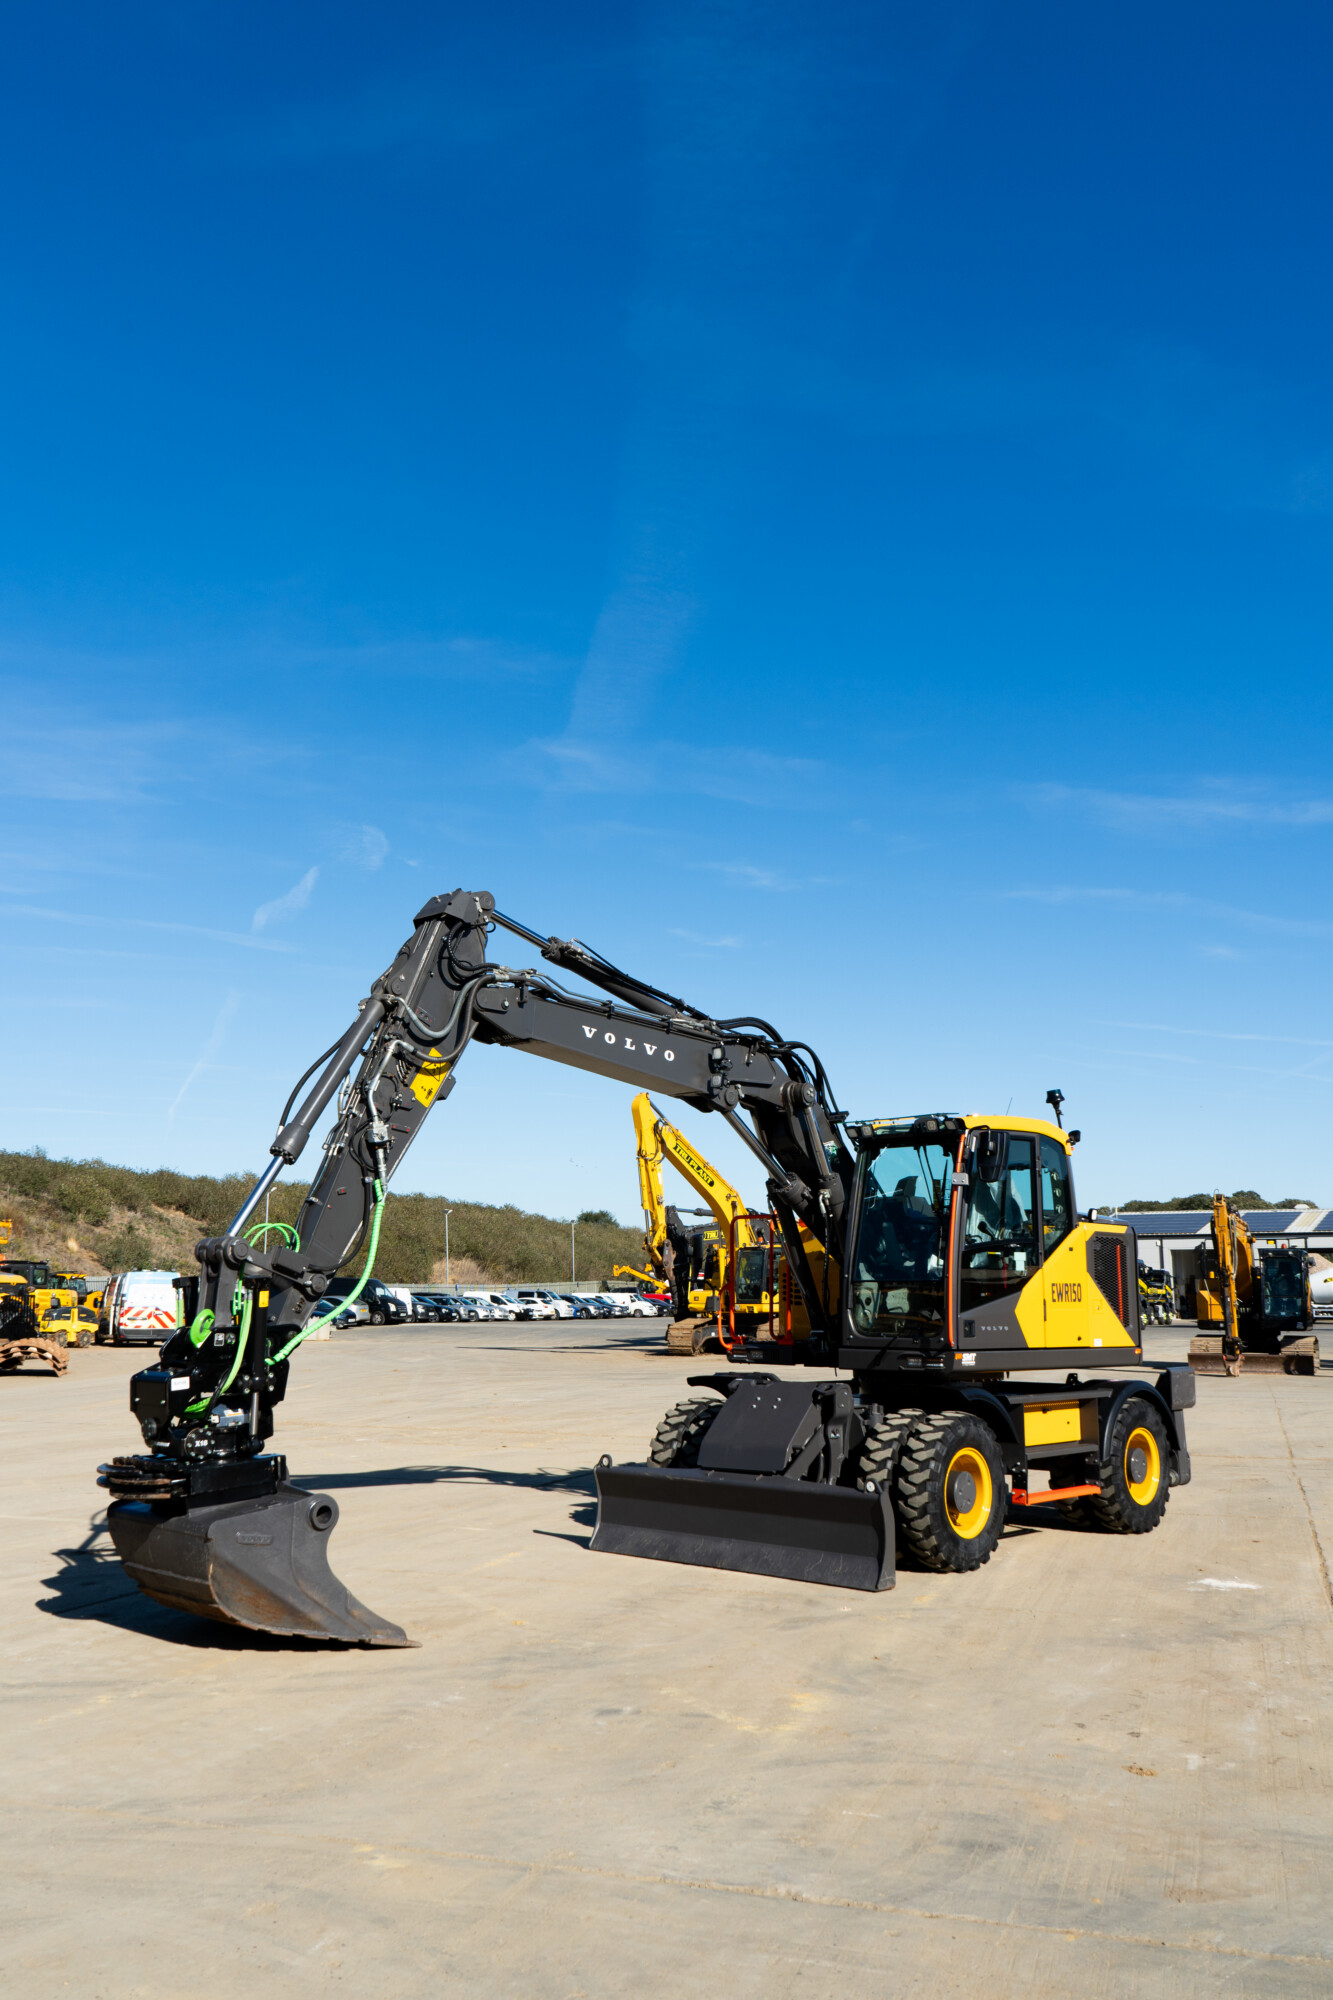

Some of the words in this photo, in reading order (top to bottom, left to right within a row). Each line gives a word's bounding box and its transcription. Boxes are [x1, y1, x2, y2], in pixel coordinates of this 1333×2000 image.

[581, 1025, 675, 1062] VOLVO
[689, 1158, 713, 1185] PLANT
[1051, 1283, 1082, 1303] EWR150
[962, 1353, 976, 1361] SMT
